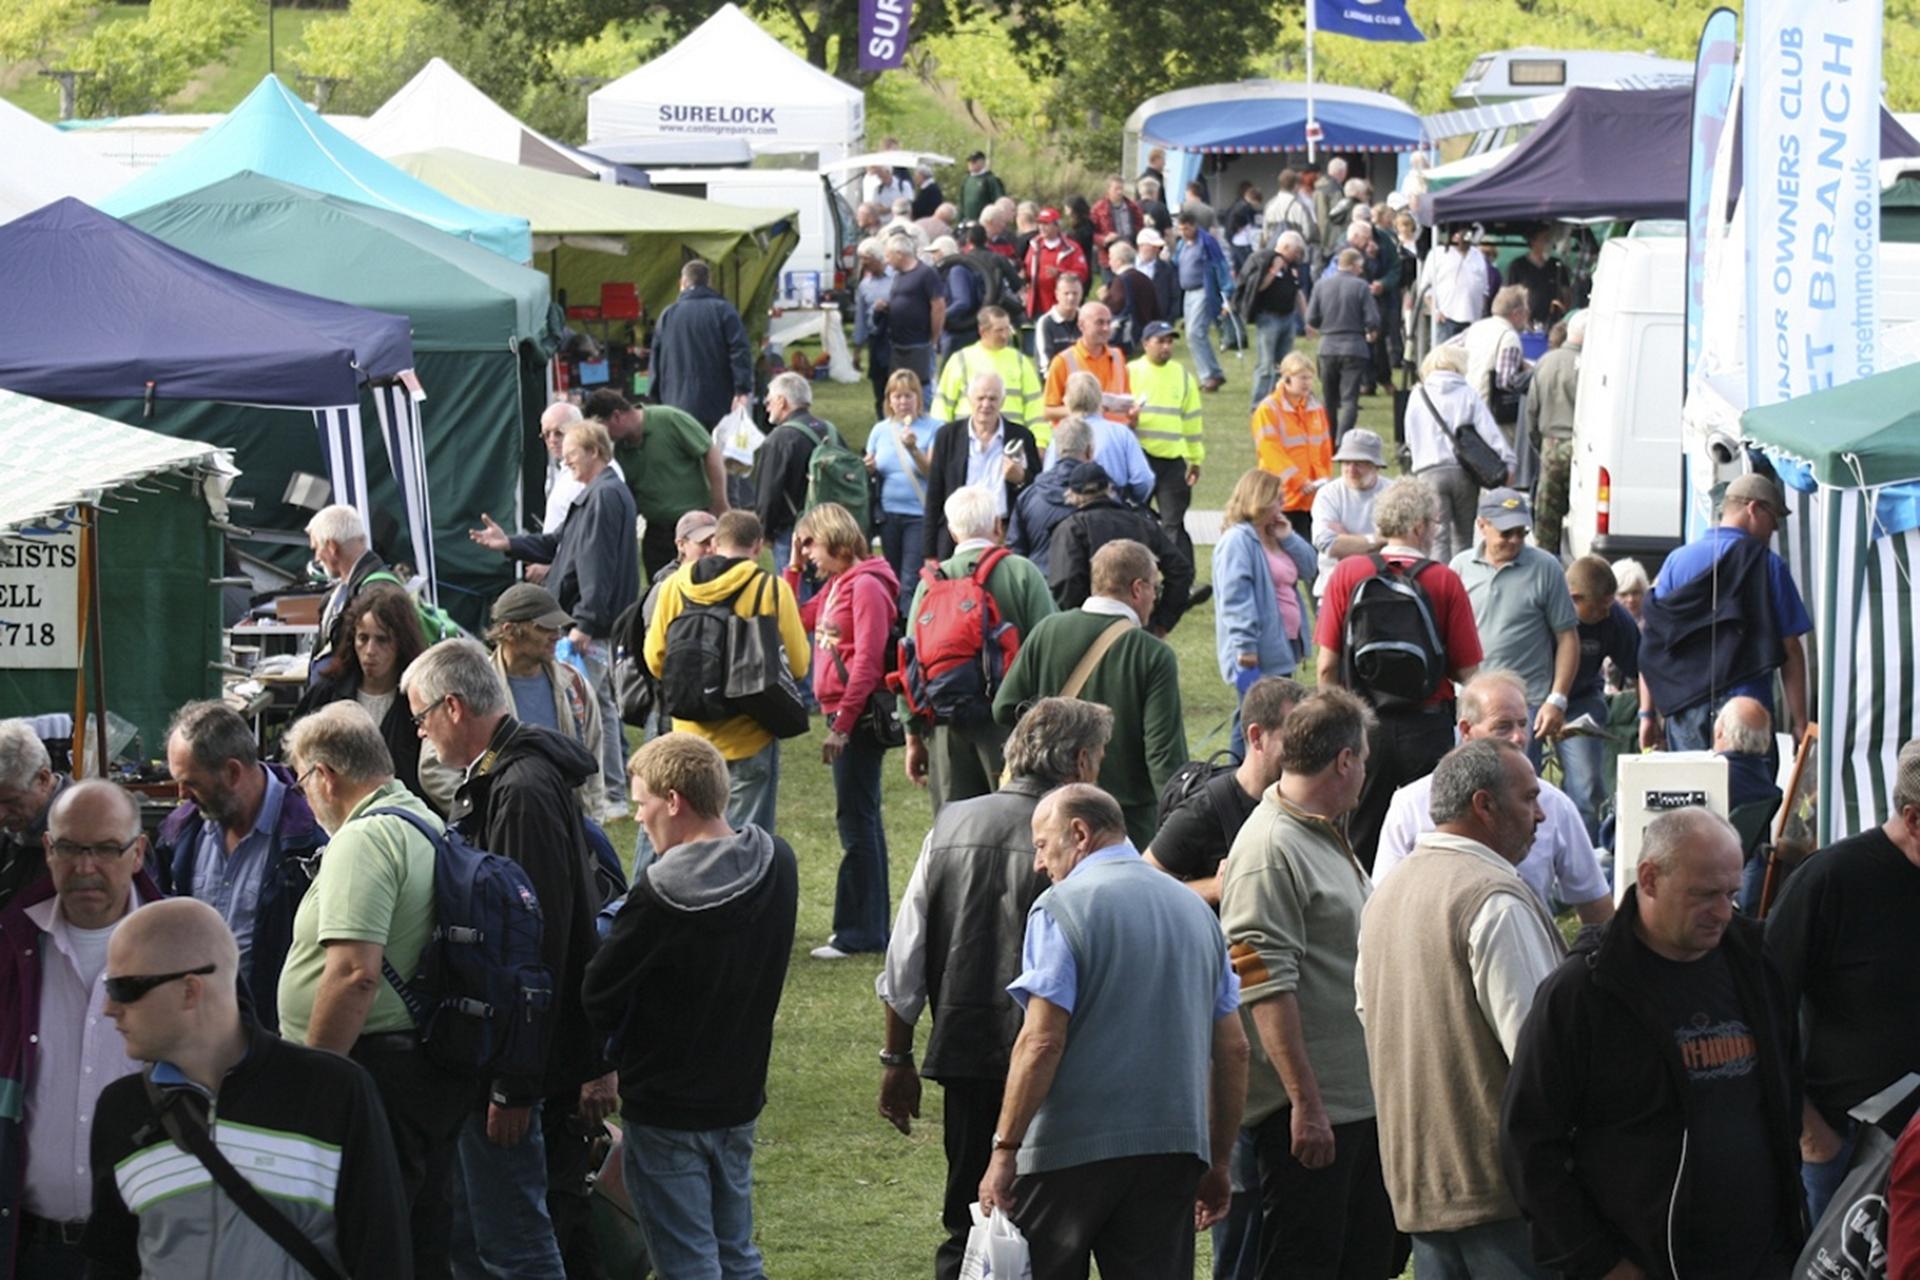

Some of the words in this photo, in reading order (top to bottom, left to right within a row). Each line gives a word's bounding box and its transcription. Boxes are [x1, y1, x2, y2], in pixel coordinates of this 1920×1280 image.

[659, 104, 776, 124] SURELOCK
[1779, 26, 1803, 119] CLUB
[659, 123, 778, 135] www.castingrepairs.com
[1808, 33, 1853, 310] BRANCH
[1773, 134, 1800, 295] OWNERS
